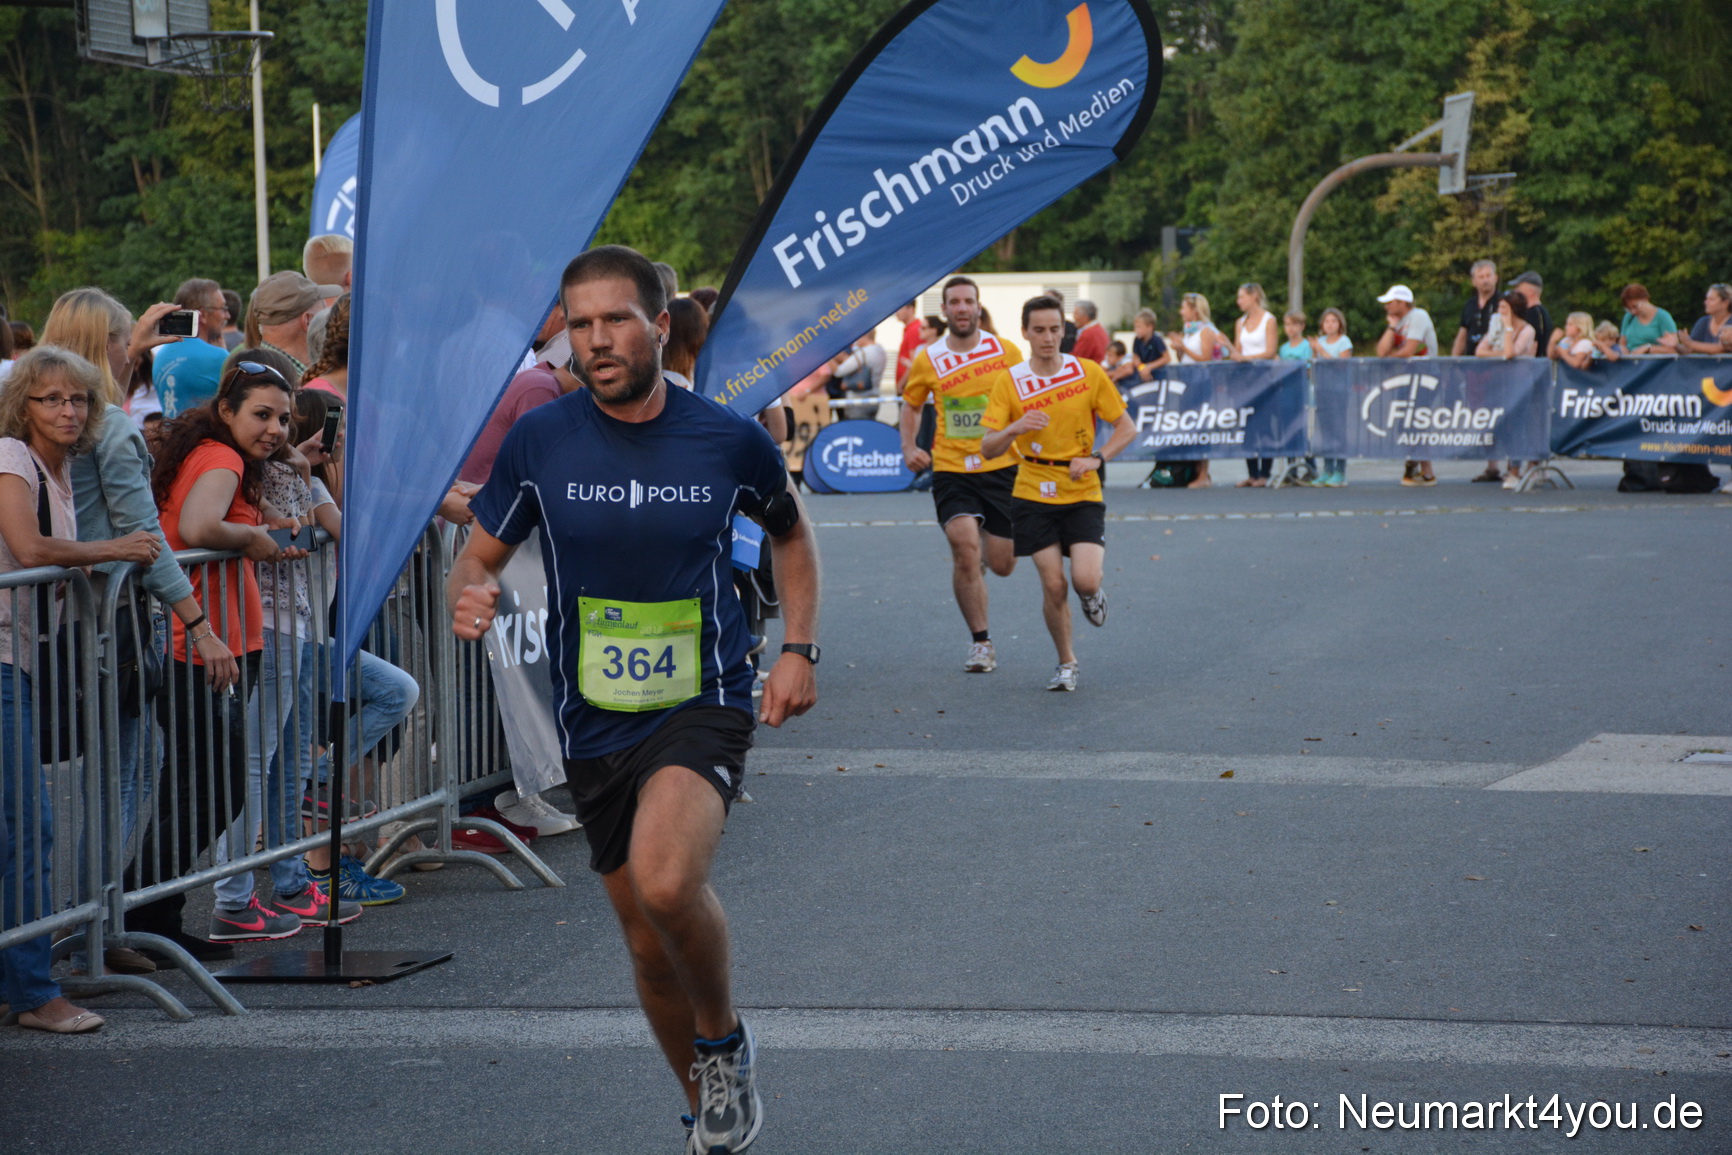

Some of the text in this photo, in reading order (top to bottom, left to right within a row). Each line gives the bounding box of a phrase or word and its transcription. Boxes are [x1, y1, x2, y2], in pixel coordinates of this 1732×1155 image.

[951, 78, 1134, 206] Druck und Medien
[773, 97, 1044, 289] Frischmann
[941, 360, 1008, 392] MAX BÖGL
[1023, 383, 1090, 413] MAX BÖGL
[1560, 388, 1702, 418] Frischmann
[953, 413, 982, 428] 902
[1136, 402, 1255, 432] Fischer
[1387, 400, 1504, 429] Fischer
[1640, 418, 1676, 433] Druck
[1678, 418, 1701, 434] und
[1142, 431, 1246, 446] AUTOMOBILE
[1397, 432, 1494, 446] AUTOMOBILE
[838, 450, 903, 468] Fischer
[846, 467, 900, 477] AUTOMOBILE
[567, 482, 712, 503] EURO POLES
[602, 645, 677, 682] 364
[613, 688, 640, 697] Jochen
